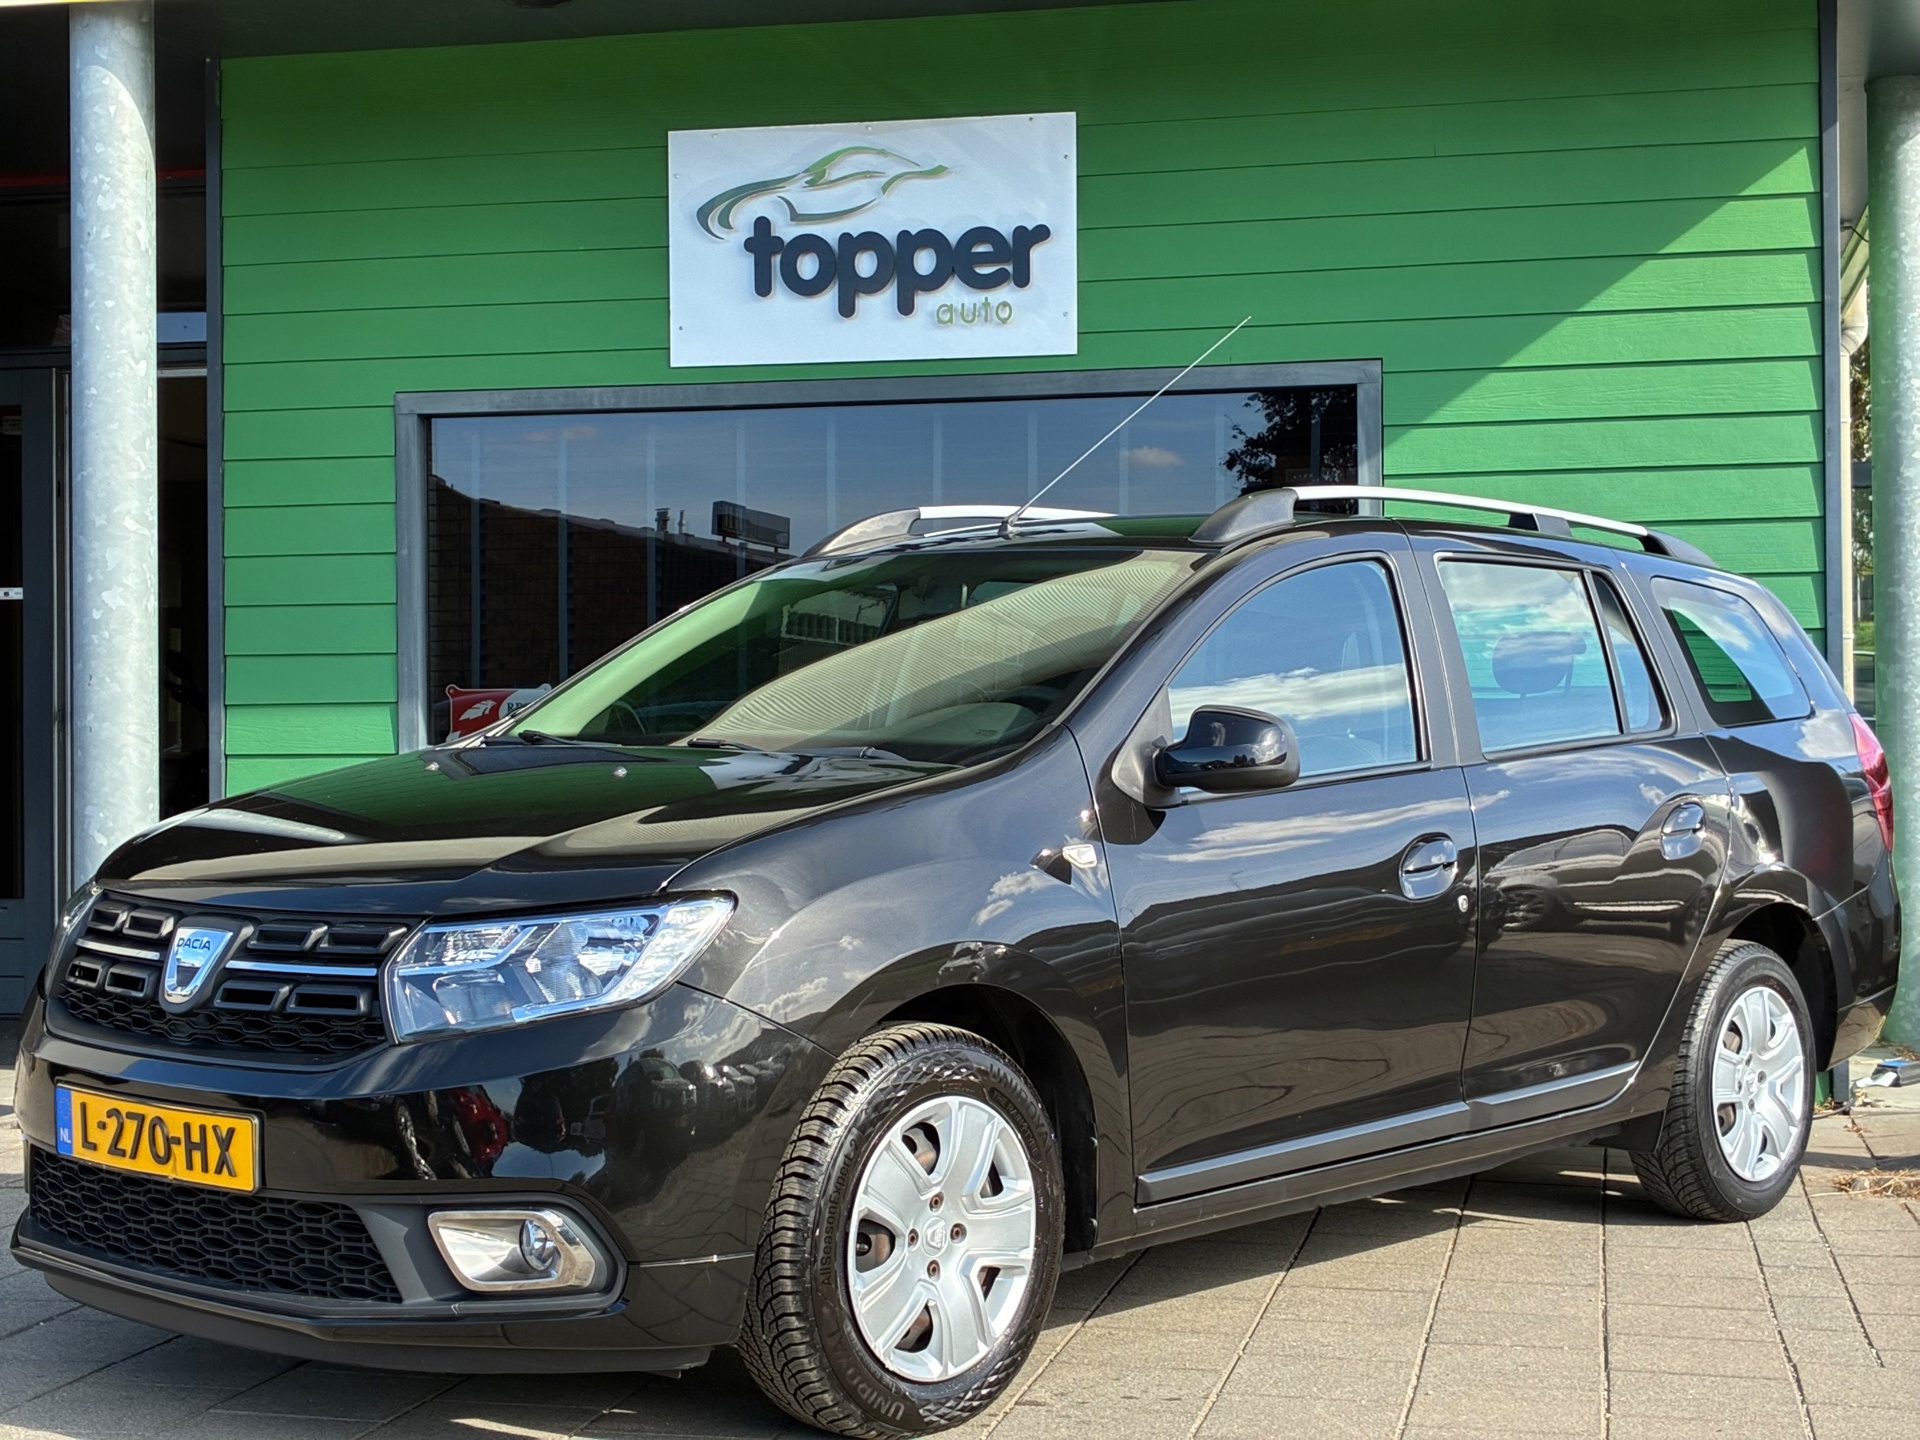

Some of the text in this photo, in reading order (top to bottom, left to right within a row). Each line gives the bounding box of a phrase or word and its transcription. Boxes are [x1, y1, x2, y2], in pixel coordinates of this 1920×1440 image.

[743, 216, 1051, 318] topper
[936, 296, 1014, 325] auto
[176, 937, 211, 951] DACIA
[59, 1127, 72, 1144] NL
[80, 1101, 236, 1178] L-270-HX
[819, 1138, 859, 1286] AllSeasonExpert 2
